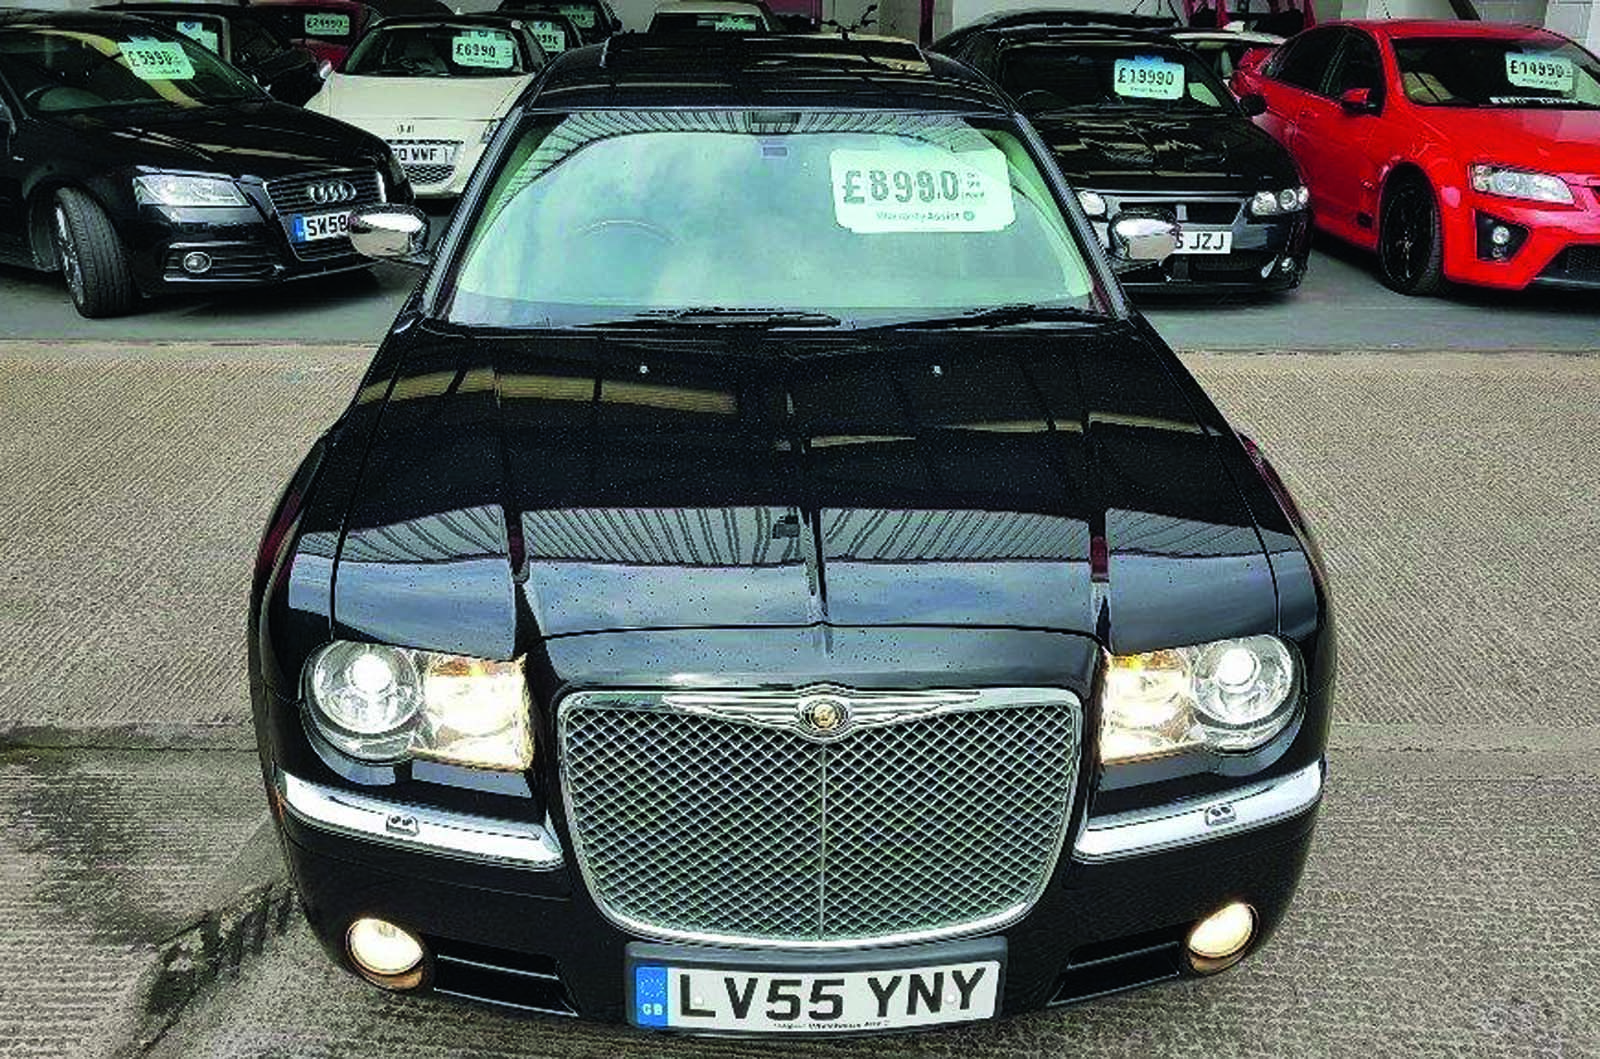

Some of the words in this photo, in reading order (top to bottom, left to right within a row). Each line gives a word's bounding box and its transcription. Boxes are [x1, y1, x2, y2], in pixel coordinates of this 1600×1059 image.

[127, 50, 173, 67] £5990
[456, 43, 496, 58] £6990
[1118, 67, 1174, 85] £19990
[842, 170, 959, 203] £8990
[1189, 232, 1224, 250] JZJ
[680, 974, 845, 1021] LV55
[867, 967, 986, 1017] YNY
[642, 1003, 663, 1016] GB
